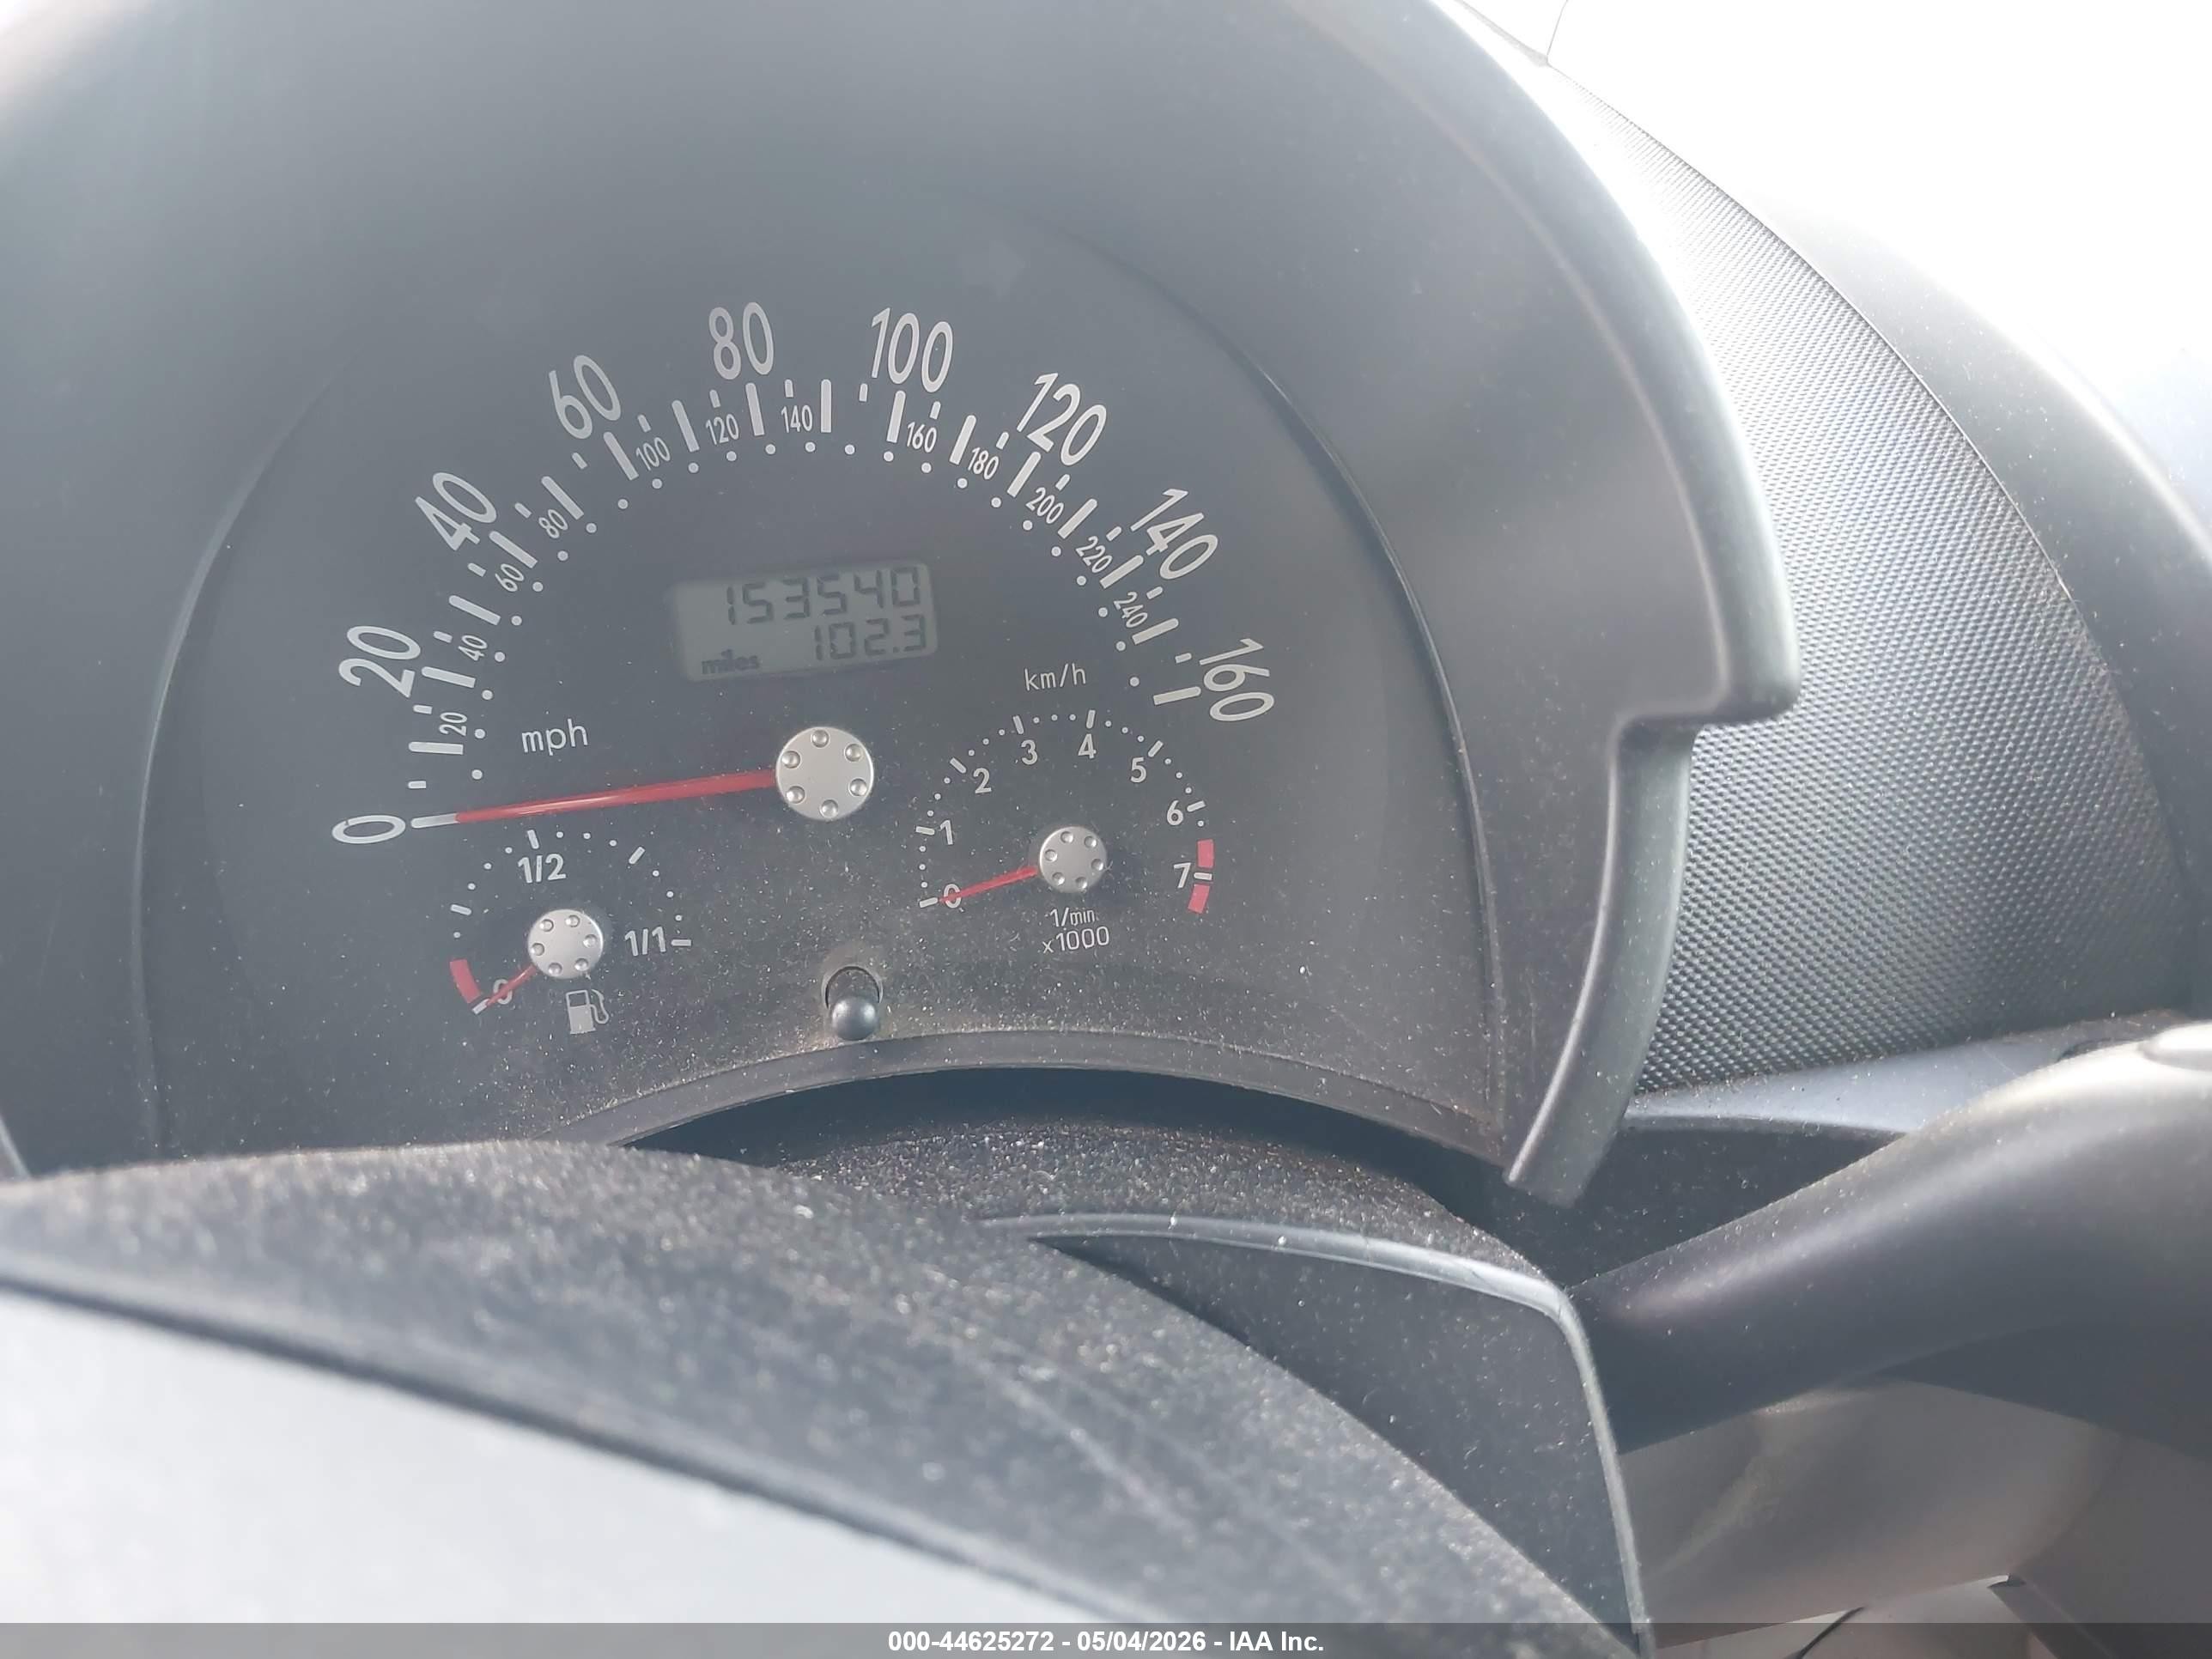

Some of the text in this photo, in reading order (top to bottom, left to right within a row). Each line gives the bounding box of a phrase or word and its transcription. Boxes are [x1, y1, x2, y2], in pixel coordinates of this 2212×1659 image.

[708, 302, 775, 380] 80
[871, 307, 953, 393] 100
[549, 355, 622, 439] 60
[706, 414, 740, 445] 120
[781, 404, 813, 433] 140
[1016, 373, 1108, 466] 120
[906, 422, 938, 453] 160
[635, 437, 672, 471] 100
[968, 447, 1000, 480] 180
[414, 471, 497, 551] 40
[1025, 487, 1065, 525] 200
[538, 508, 568, 539] 80
[1130, 488, 1218, 580] 140
[1075, 536, 1114, 574] 220
[495, 562, 526, 592] 60
[726, 567, 921, 625] 153540
[1114, 591, 1148, 629] 240
[458, 635, 489, 662] 40
[814, 614, 927, 661] 102.3
[337, 625, 422, 698] 20
[701, 648, 761, 675] miles
[1024, 663, 1087, 691] km/h
[1199, 638, 1275, 722] 160
[439, 712, 468, 736] 20
[520, 719, 589, 756] mph
[1021, 739, 1038, 765] 3
[1077, 733, 1097, 759] 4
[973, 768, 992, 794] 2
[1130, 757, 1147, 782] 5
[1166, 799, 1183, 826] 6
[331, 814, 406, 844] 0
[939, 819, 953, 845] 1
[518, 854, 567, 884] 1/2
[1173, 862, 1192, 889] 7
[1049, 908, 1096, 928] 1/min
[624, 927, 667, 957] 1/1
[1042, 926, 1110, 954] x1000
